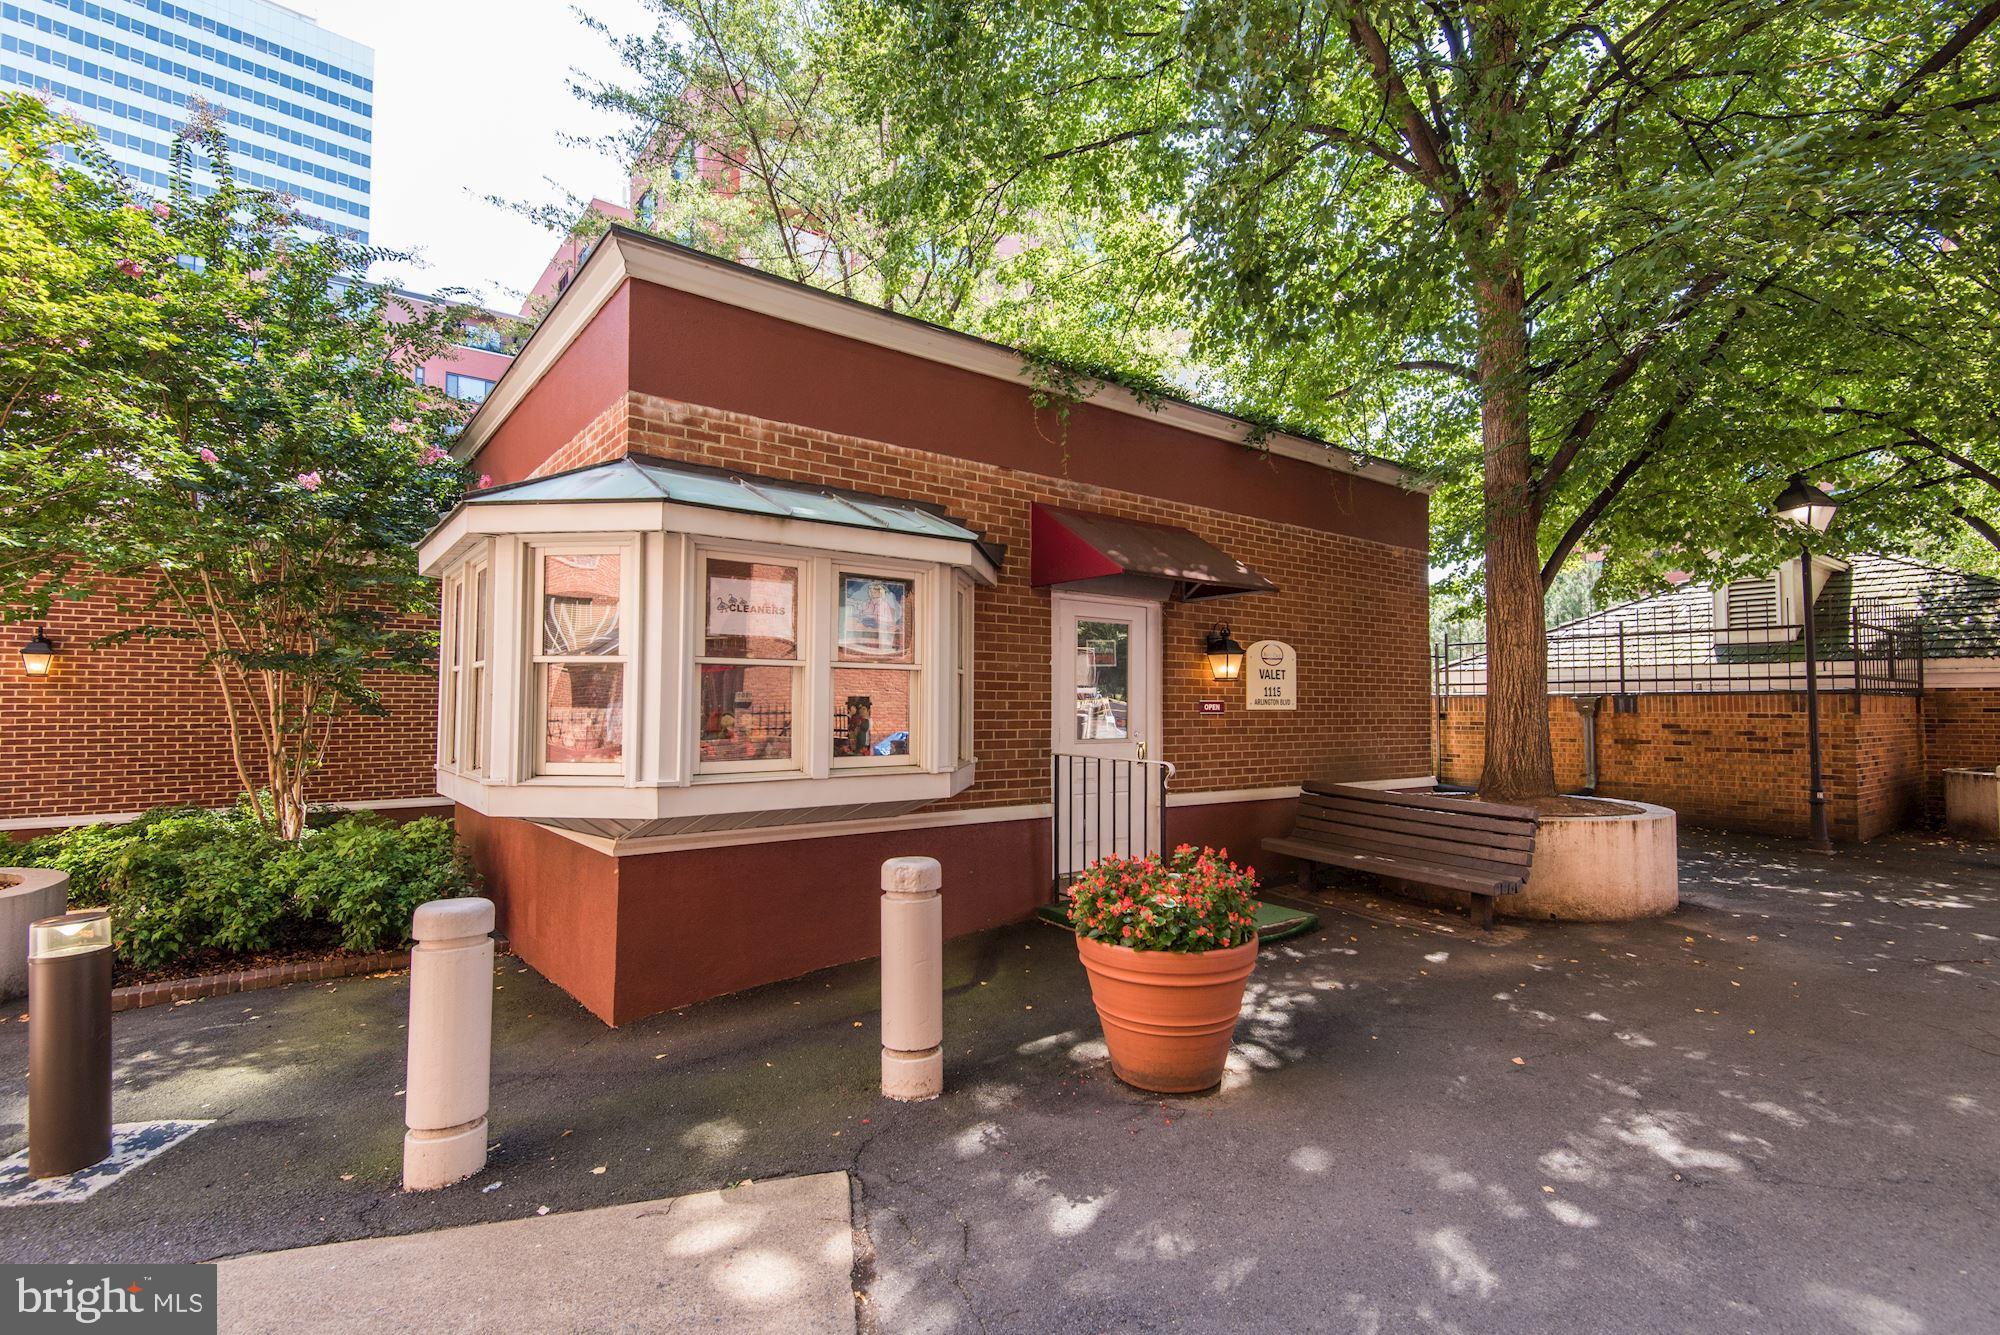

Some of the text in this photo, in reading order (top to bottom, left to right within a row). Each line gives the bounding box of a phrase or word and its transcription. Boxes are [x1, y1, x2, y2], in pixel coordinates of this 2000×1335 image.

[729, 603, 786, 616] CLEANERS
[1259, 668, 1286, 680] VALET
[1264, 686, 1281, 697] 1115
[1204, 703, 1221, 711] OPEN
[1254, 698, 1291, 706] ARLINGTON BLVD
